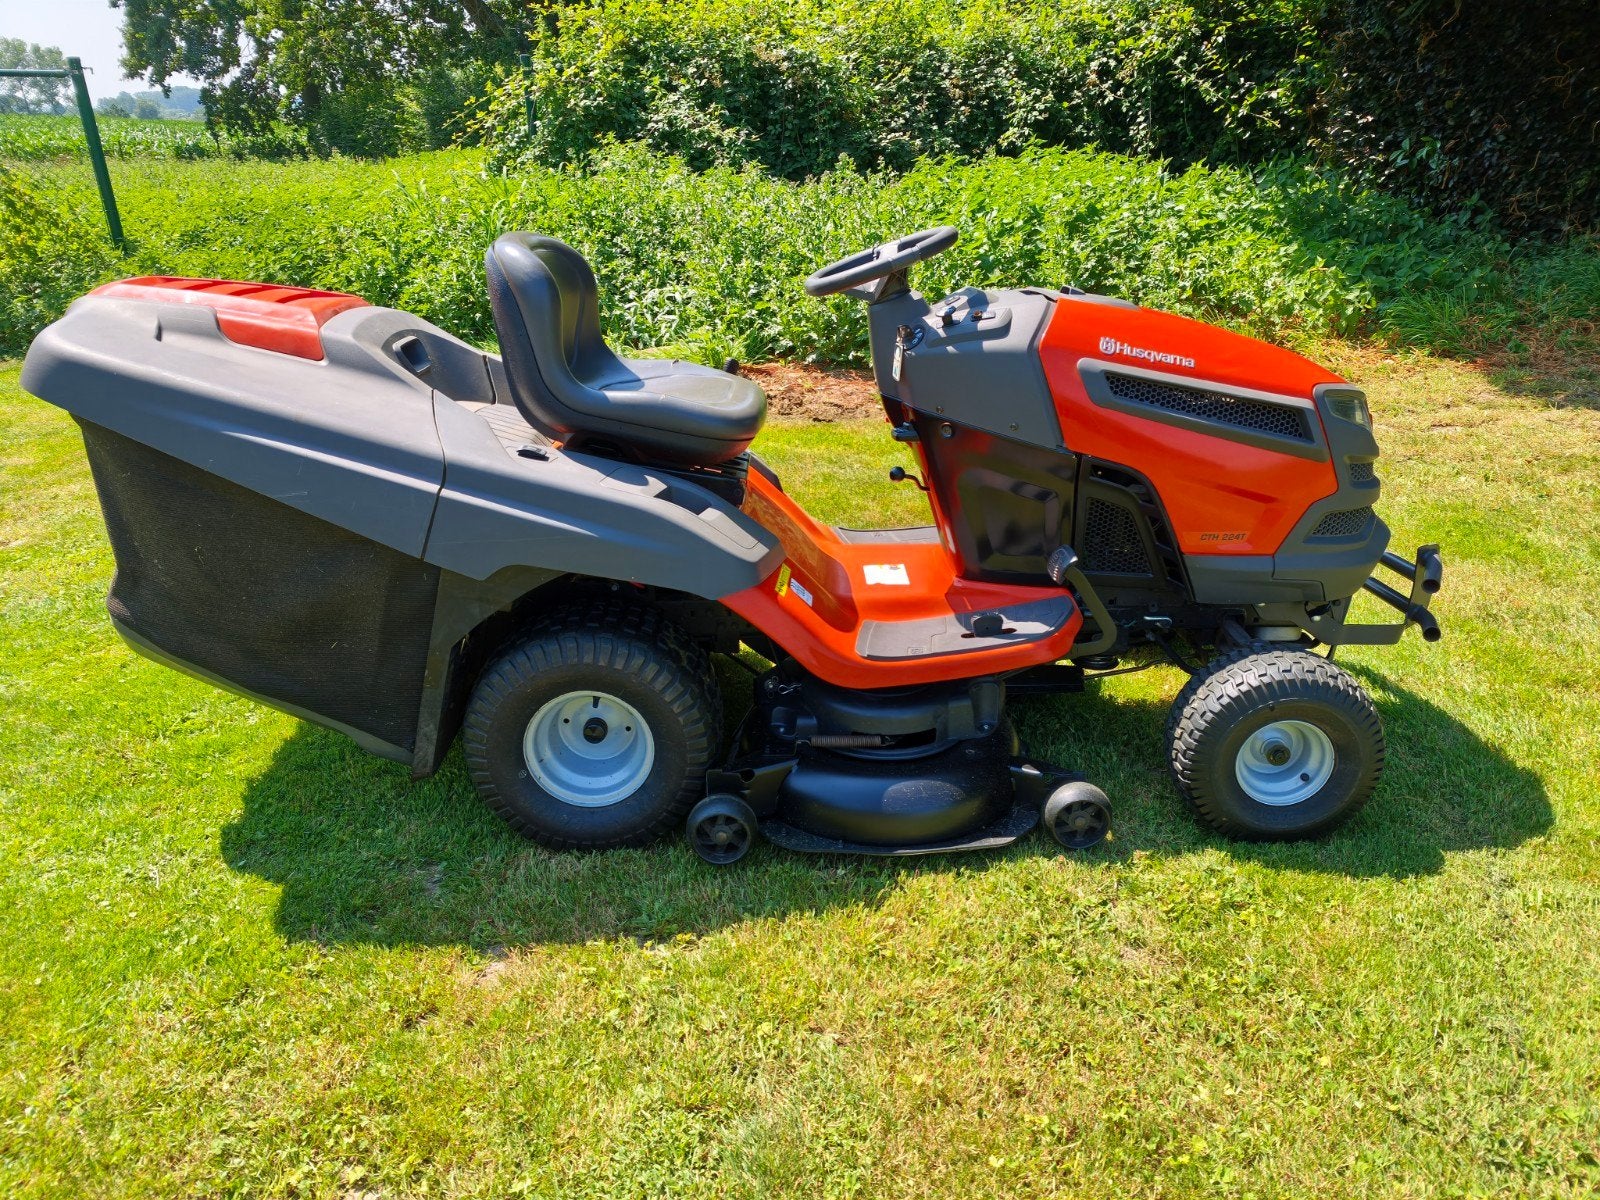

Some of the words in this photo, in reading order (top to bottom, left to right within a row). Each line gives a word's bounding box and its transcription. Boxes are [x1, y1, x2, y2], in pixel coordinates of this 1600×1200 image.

[1116, 341, 1195, 368] Husqvarna
[1200, 533, 1219, 541] CTH
[1222, 533, 1246, 541] 224T
